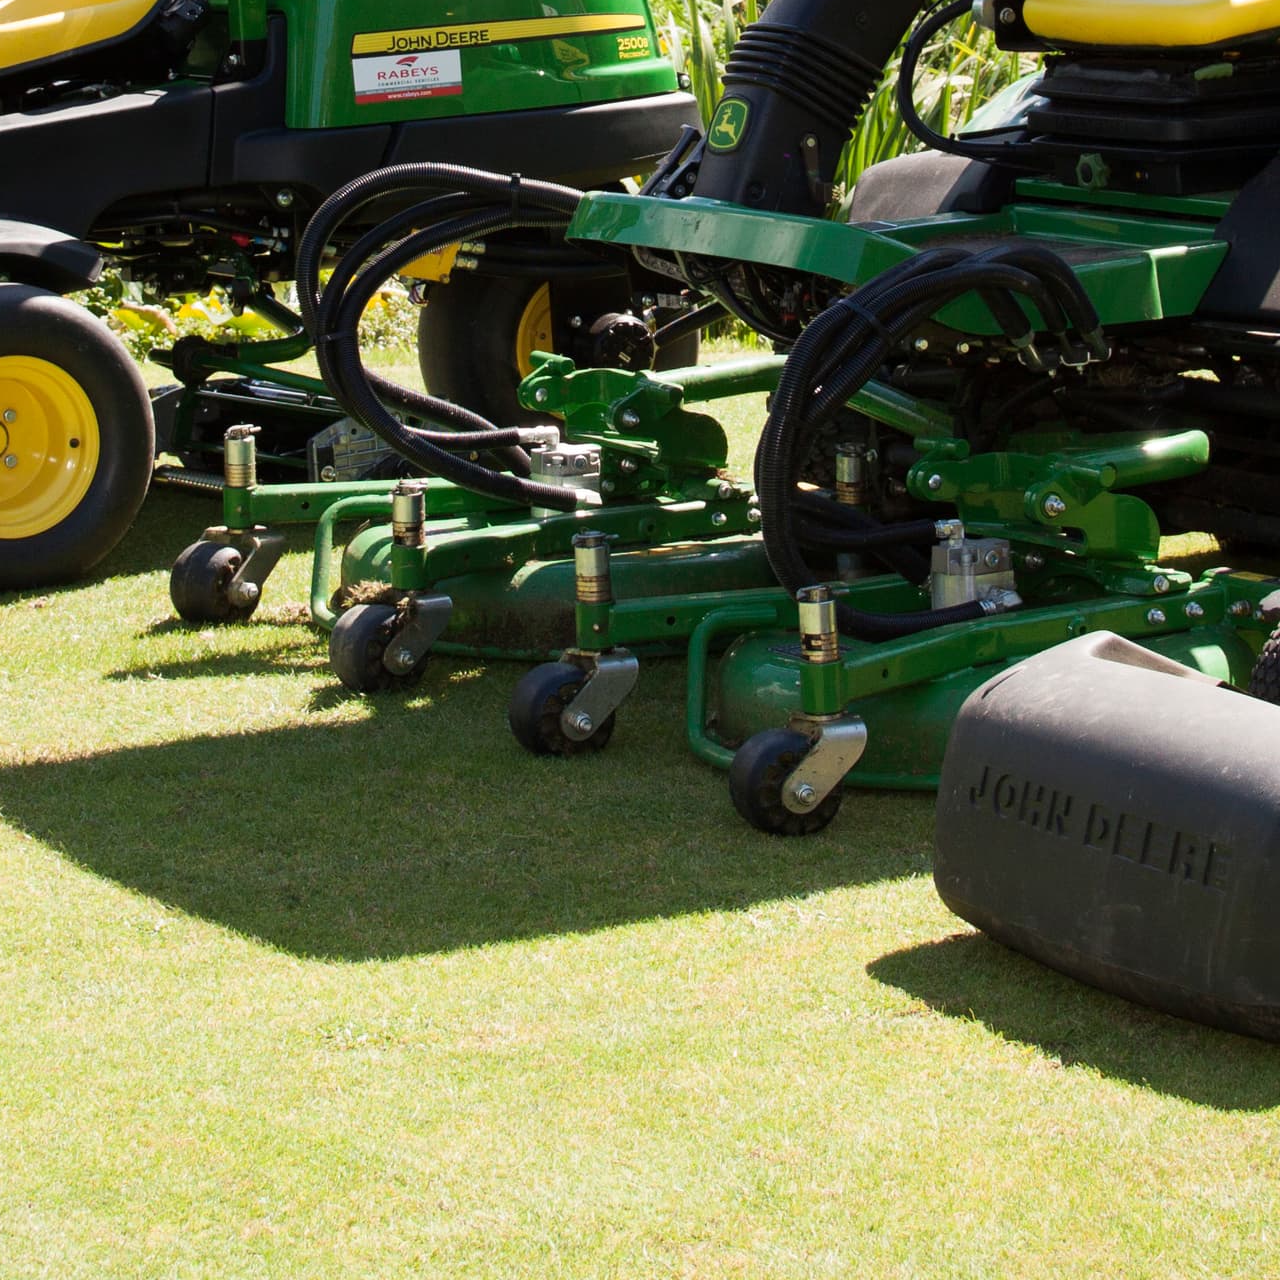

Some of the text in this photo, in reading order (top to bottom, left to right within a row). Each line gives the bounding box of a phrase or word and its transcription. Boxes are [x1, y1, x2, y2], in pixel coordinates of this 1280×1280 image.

[387, 29, 490, 51] JOHN DEERE
[377, 66, 439, 80] RABEYS
[970, 765, 1073, 839] JOHN
